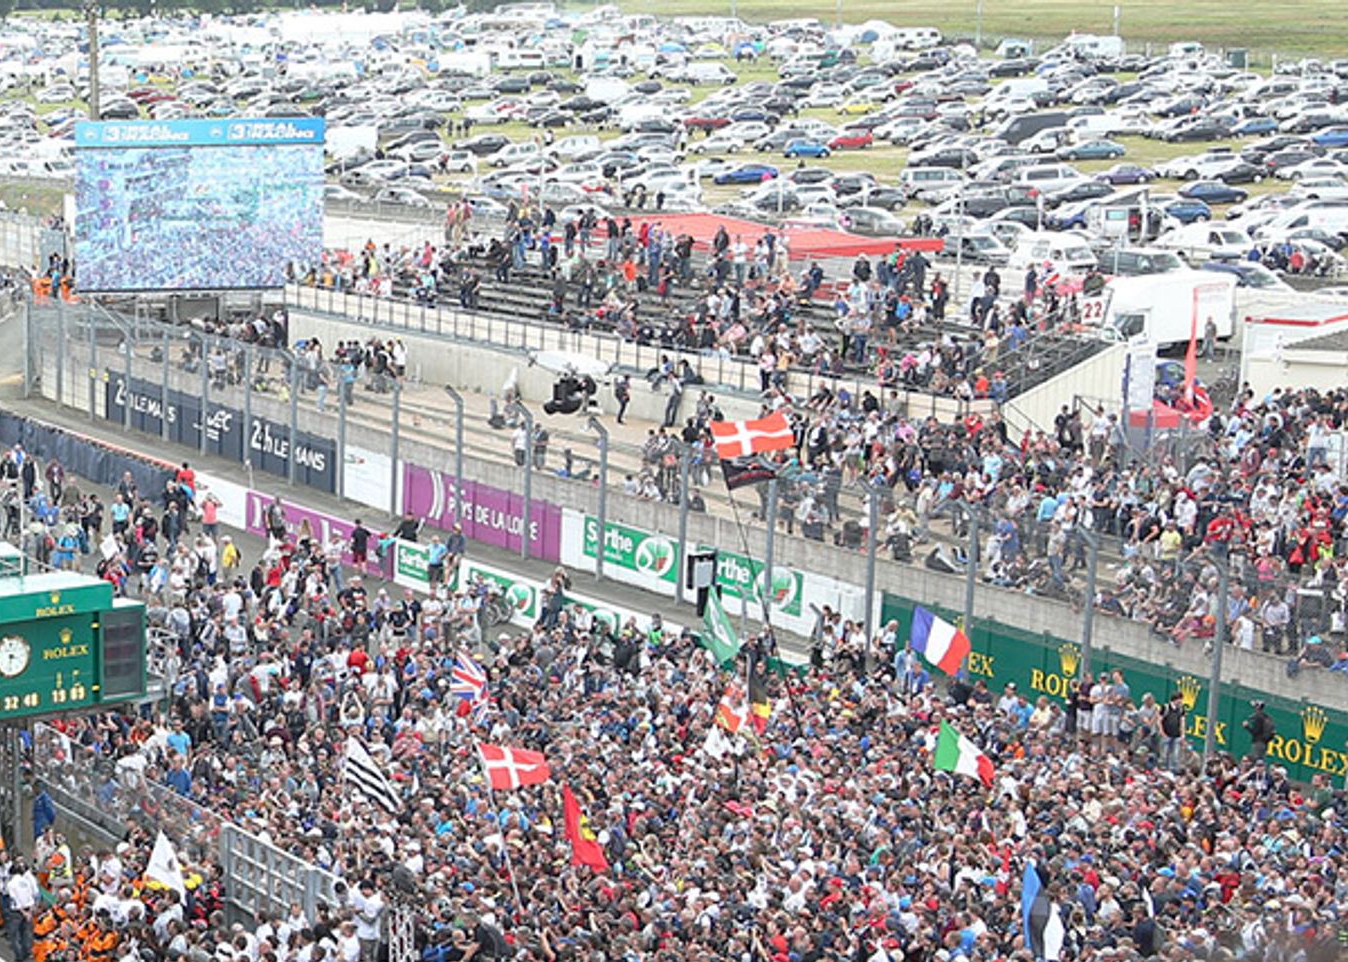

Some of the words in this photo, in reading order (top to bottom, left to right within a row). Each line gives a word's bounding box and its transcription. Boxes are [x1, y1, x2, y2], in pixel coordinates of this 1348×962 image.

[1083, 301, 1103, 319] 22
[147, 396, 177, 423] MAS
[273, 438, 289, 458] LE
[447, 497, 474, 521] PYS
[475, 505, 490, 526] DE
[491, 509, 507, 529] LA
[507, 514, 539, 541] LOIE
[586, 518, 633, 553] Srthe
[35, 604, 75, 618] ROLEX
[43, 645, 89, 660] ROLEX
